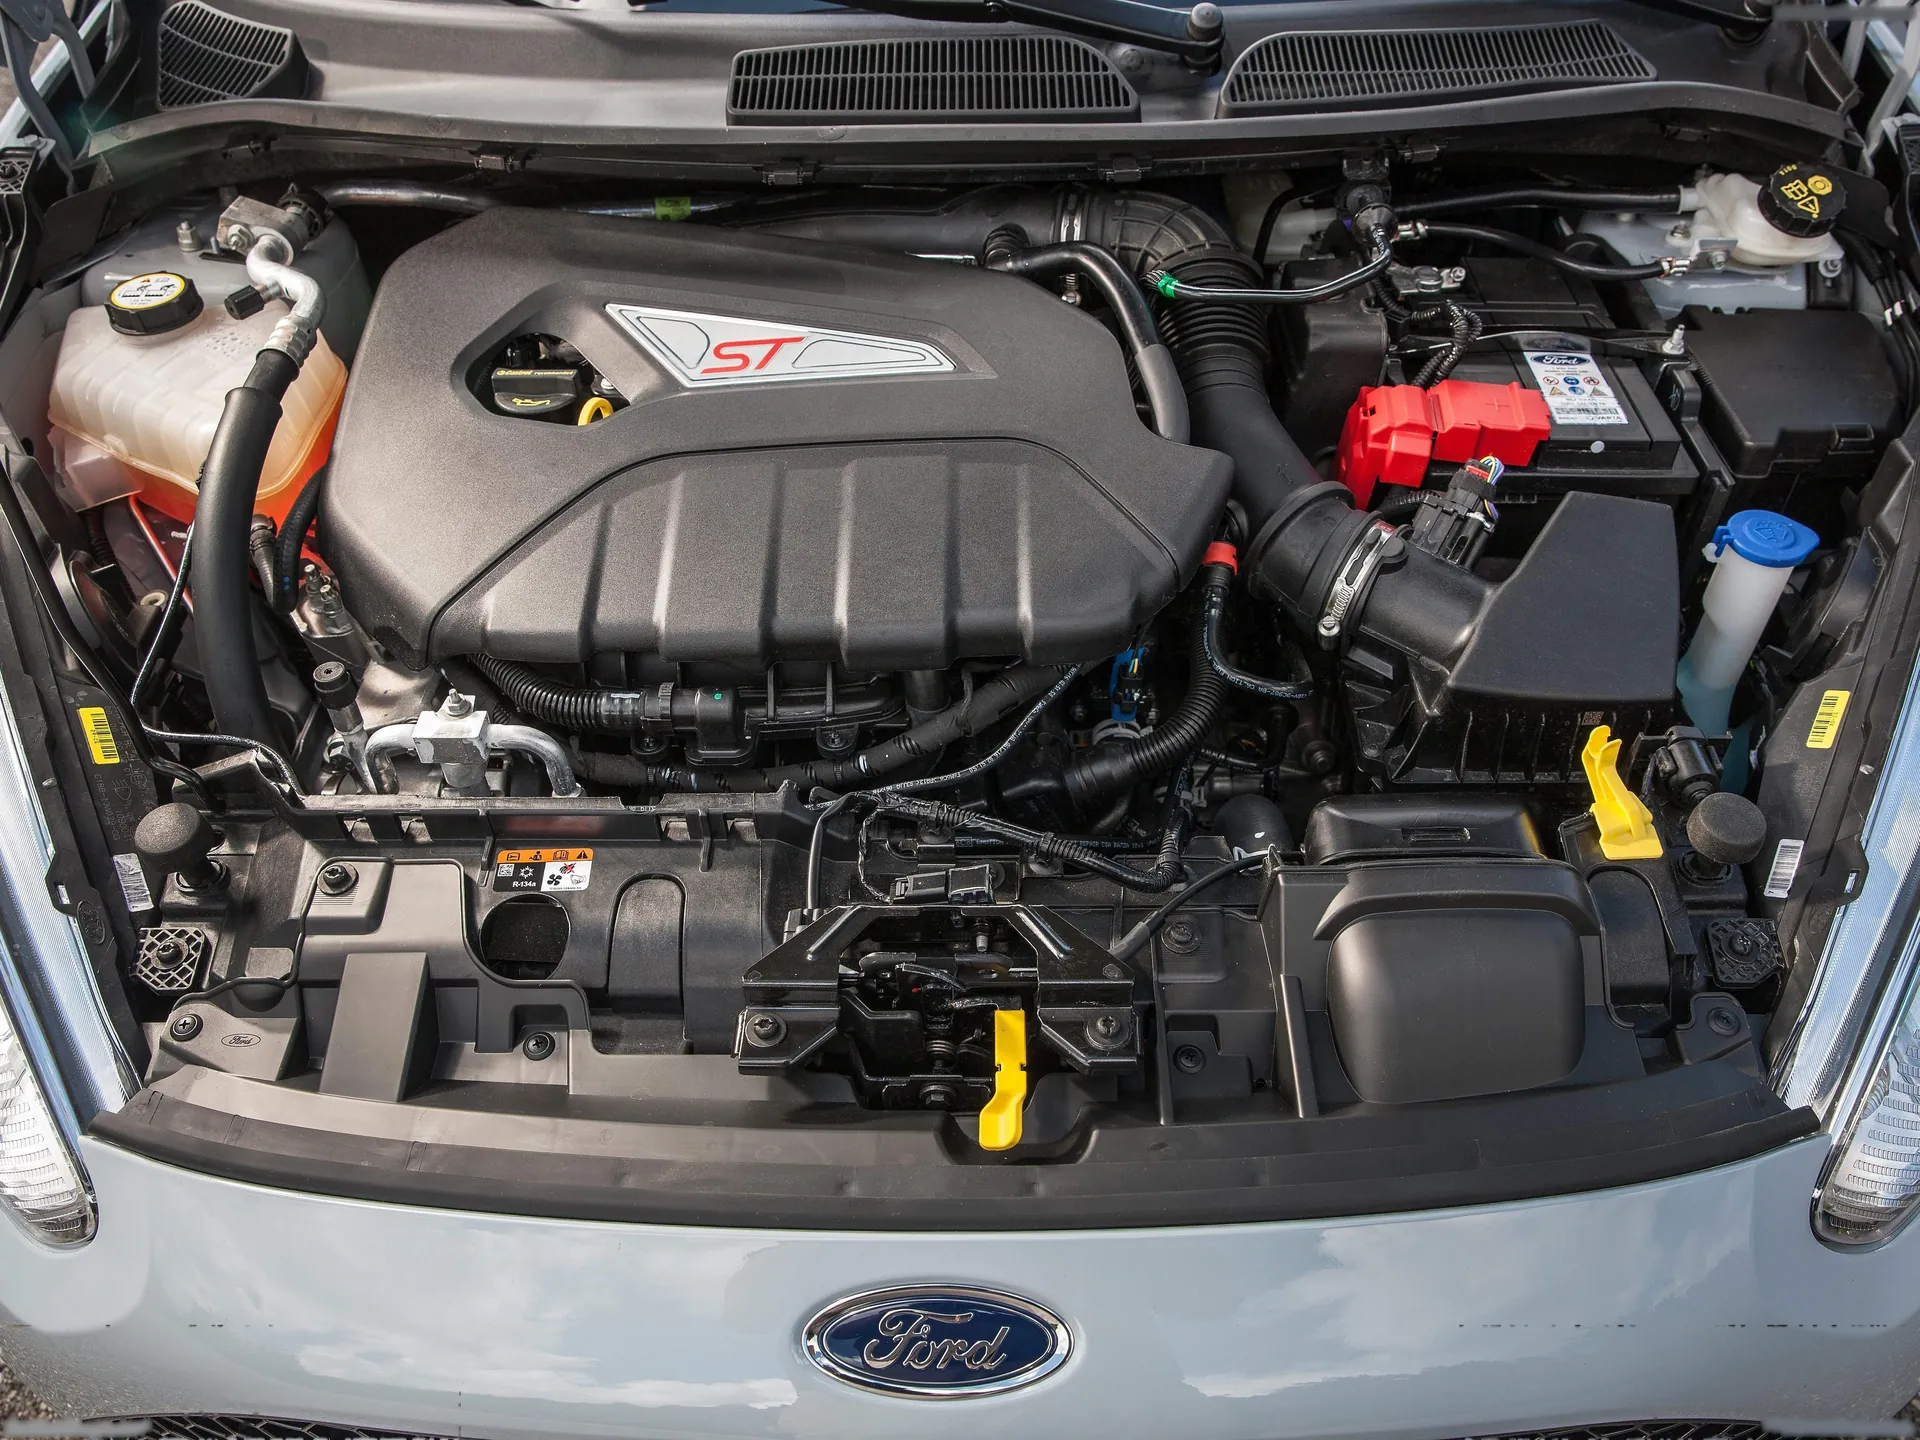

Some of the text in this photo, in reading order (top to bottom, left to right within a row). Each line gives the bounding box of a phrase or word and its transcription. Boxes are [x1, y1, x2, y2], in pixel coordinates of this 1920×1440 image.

[700, 336, 806, 374] ST
[1543, 355, 1578, 365] Ford
[228, 1035, 254, 1045] Ford
[864, 1308, 1010, 1370] Ford
